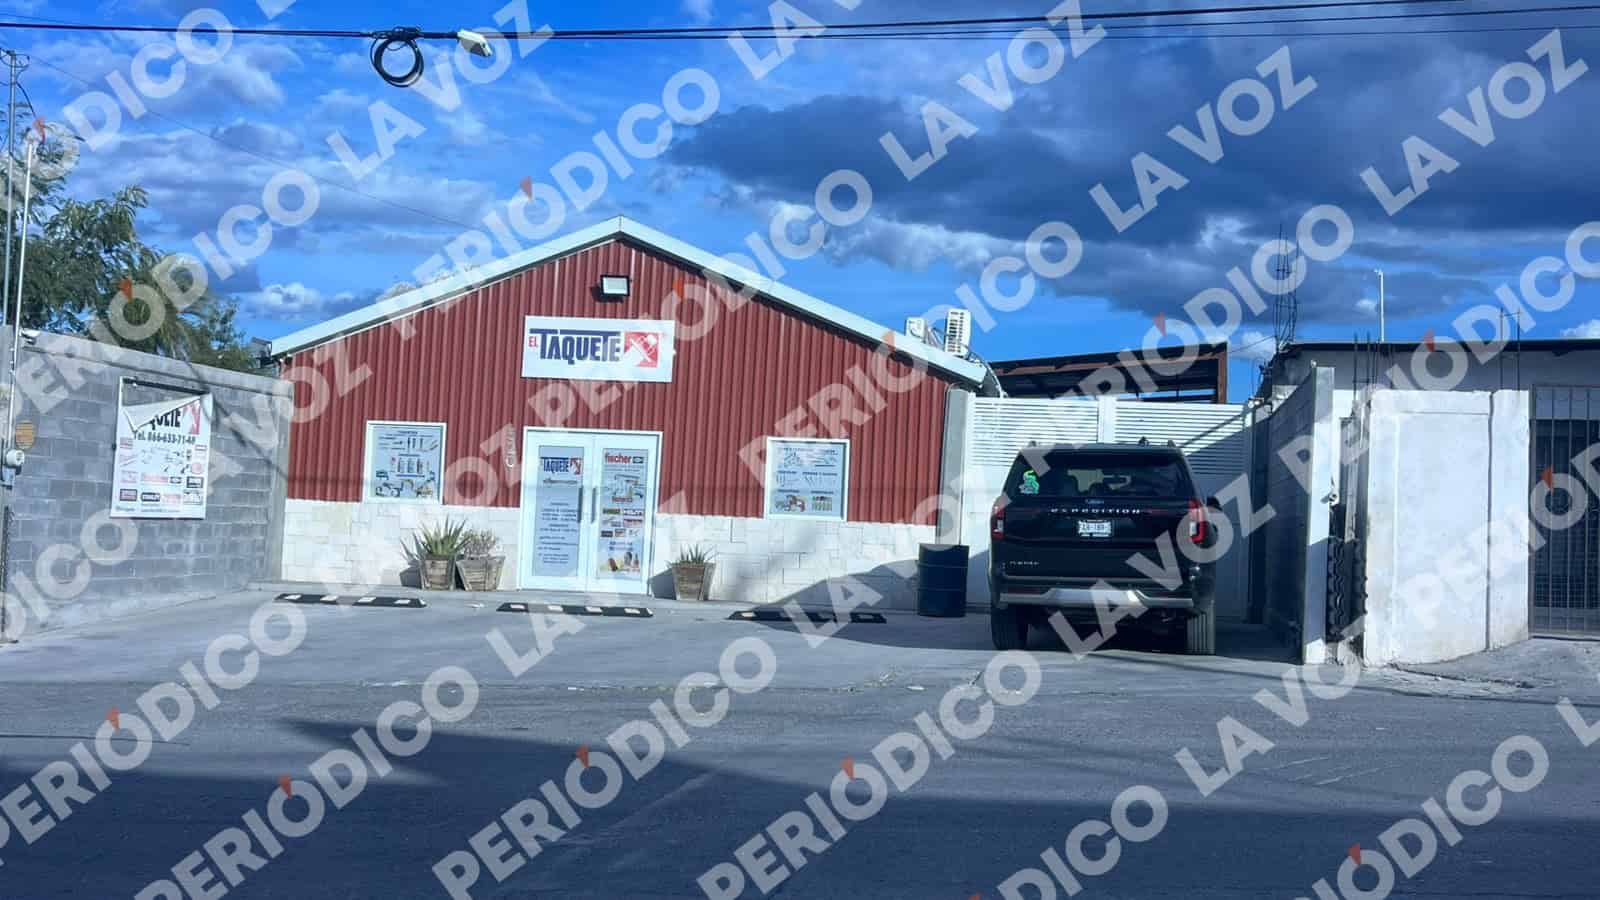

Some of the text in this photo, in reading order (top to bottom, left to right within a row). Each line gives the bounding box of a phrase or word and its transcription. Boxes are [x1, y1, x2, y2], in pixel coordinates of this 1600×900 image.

[528, 328, 621, 365] EL TAQUETE
[541, 457, 569, 474] TAQUETE
